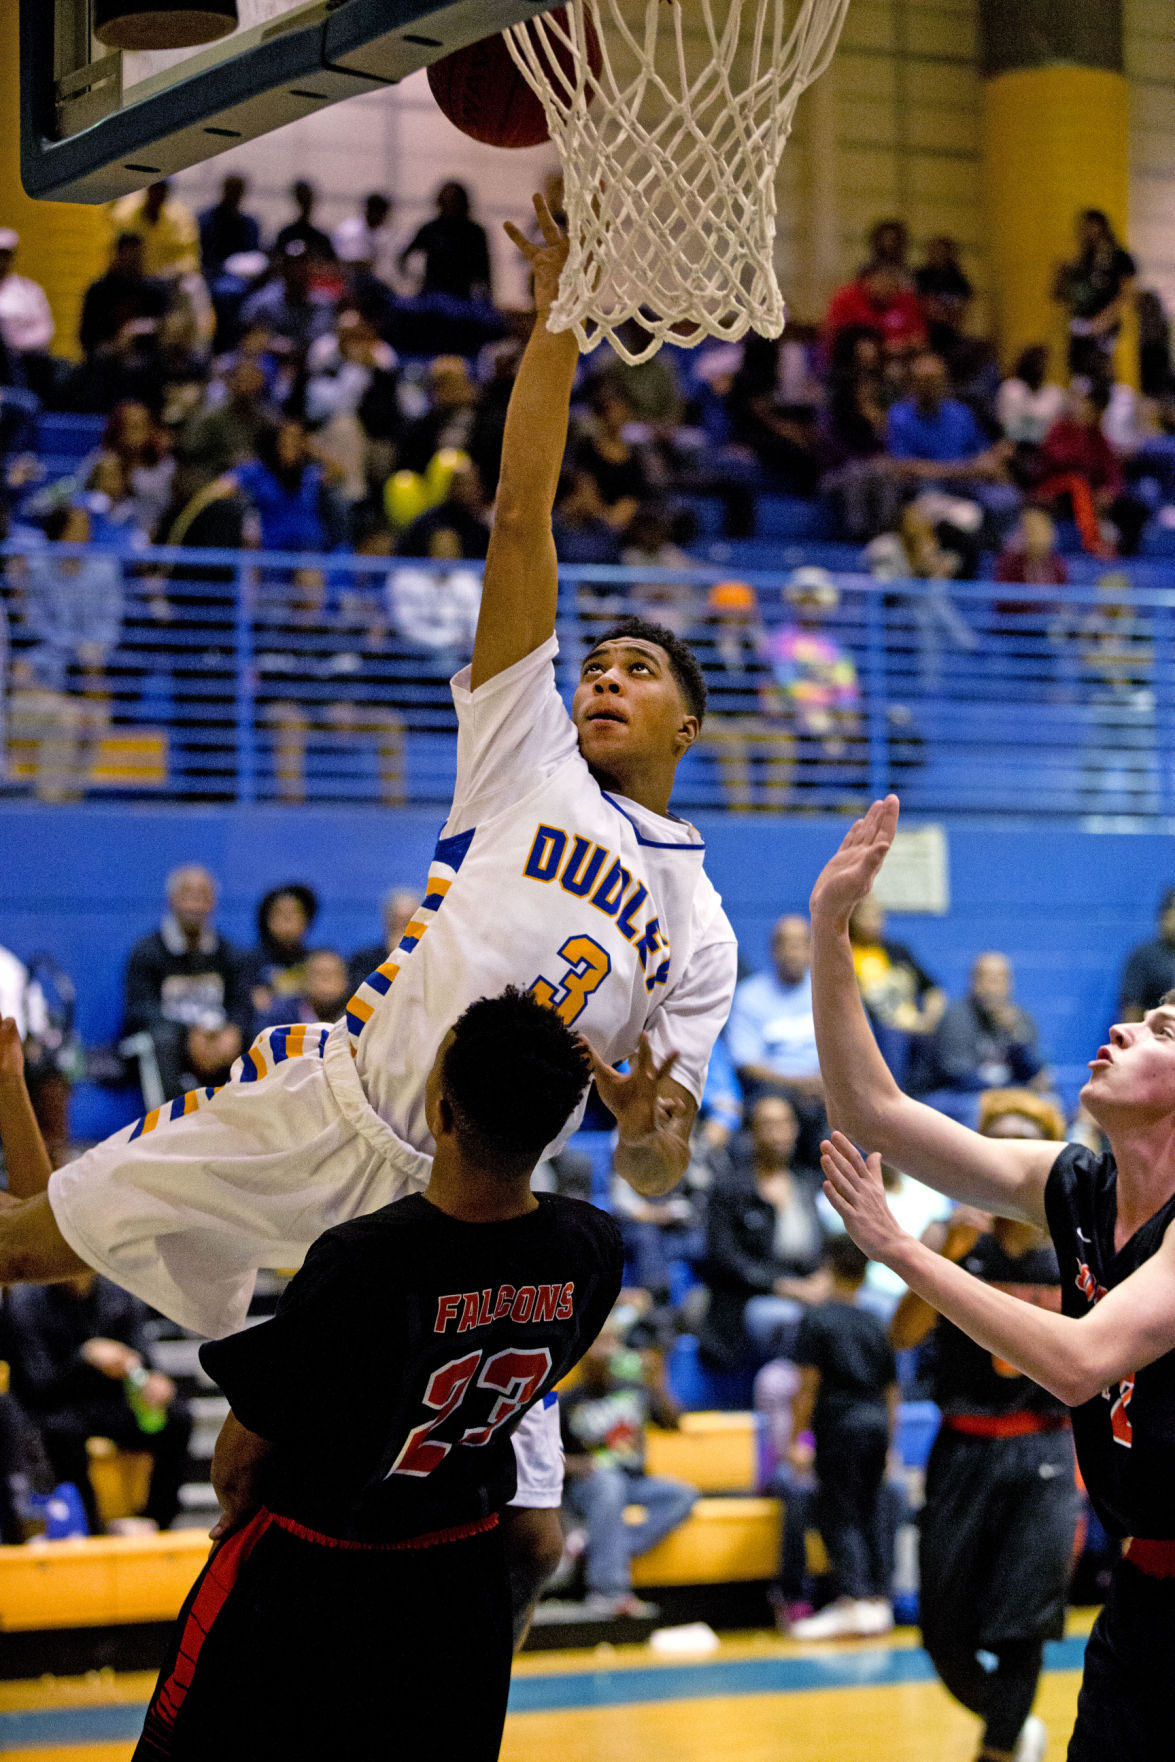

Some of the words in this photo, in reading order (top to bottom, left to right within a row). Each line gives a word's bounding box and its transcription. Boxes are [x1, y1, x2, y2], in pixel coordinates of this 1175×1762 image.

[528, 934, 612, 1028] 3
[433, 1282, 574, 1333] FALCONS
[383, 1347, 553, 1481] 23
